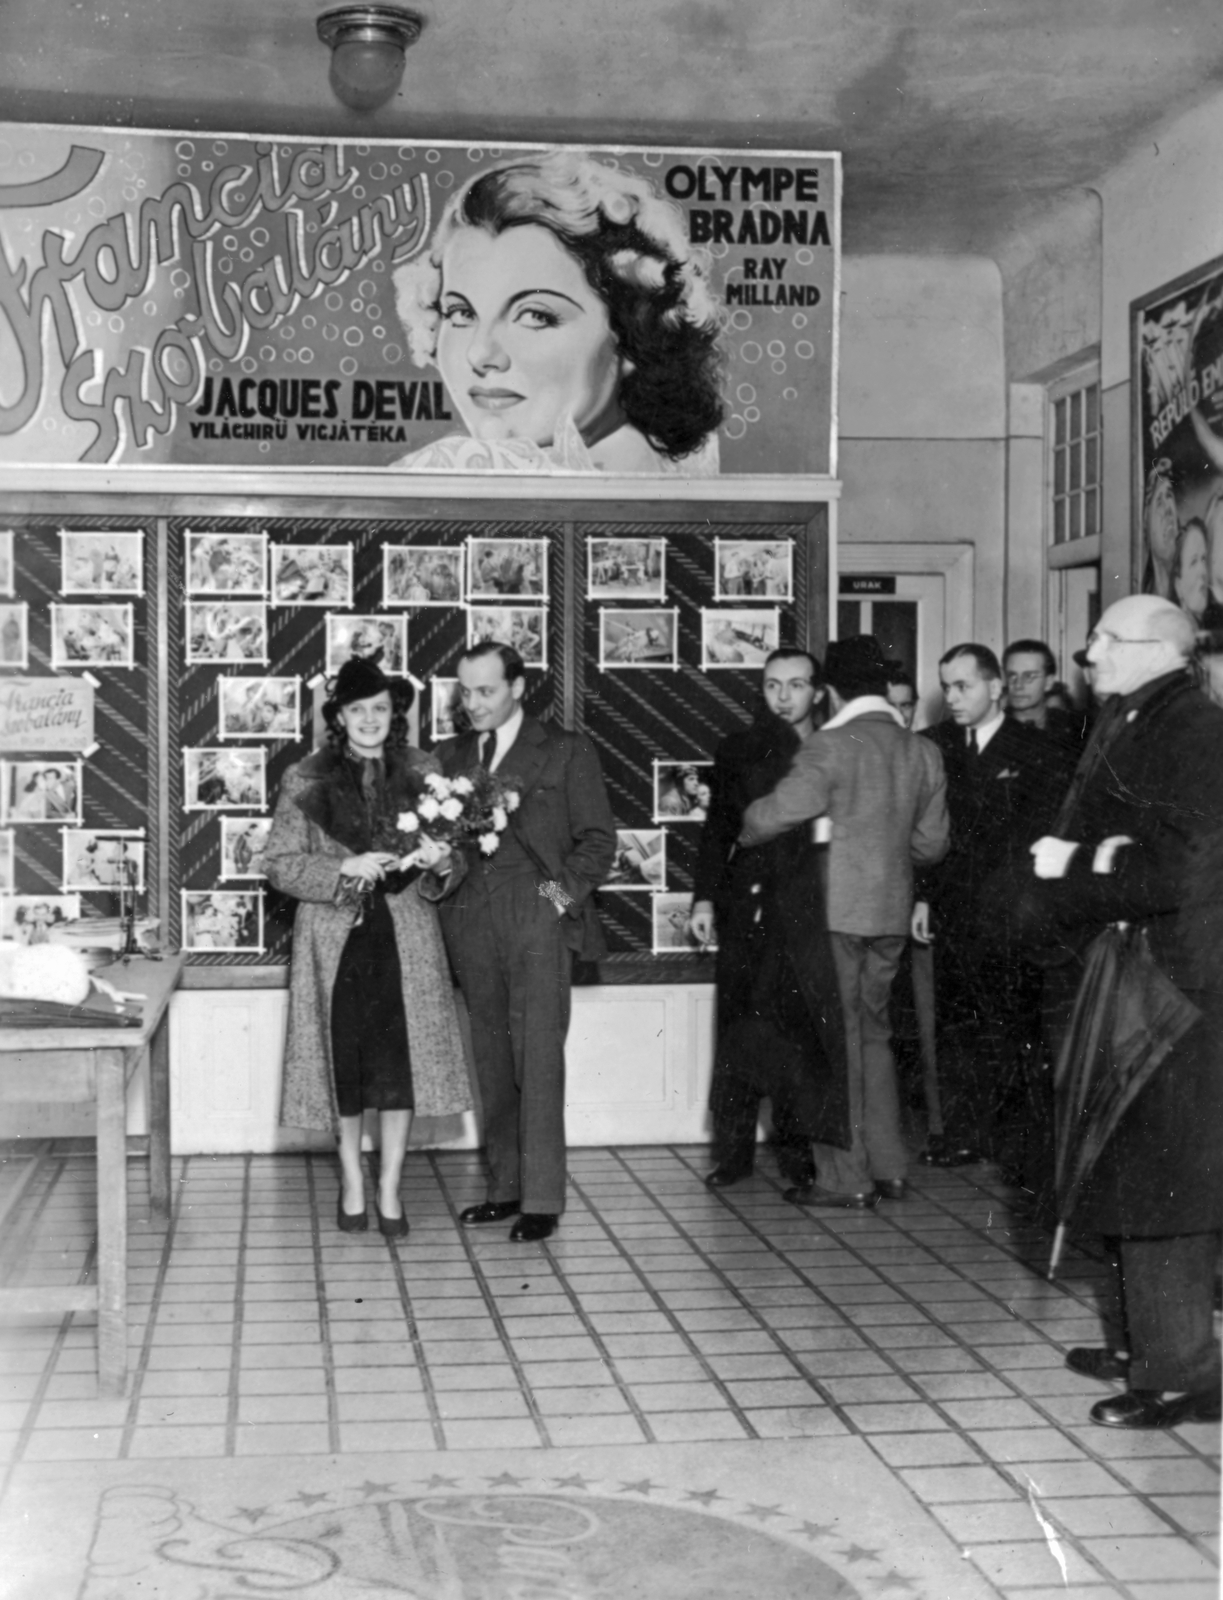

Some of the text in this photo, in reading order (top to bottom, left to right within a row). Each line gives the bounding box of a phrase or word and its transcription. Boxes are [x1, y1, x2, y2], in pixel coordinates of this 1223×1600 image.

[665, 164, 819, 202] OLYMPE
[689, 209, 831, 245] BRADNA
[743, 257, 788, 280] RAY
[725, 284, 821, 306] MILLAND
[195, 377, 453, 421] JACQUES DEVAL
[853, 581, 882, 589] URAK
